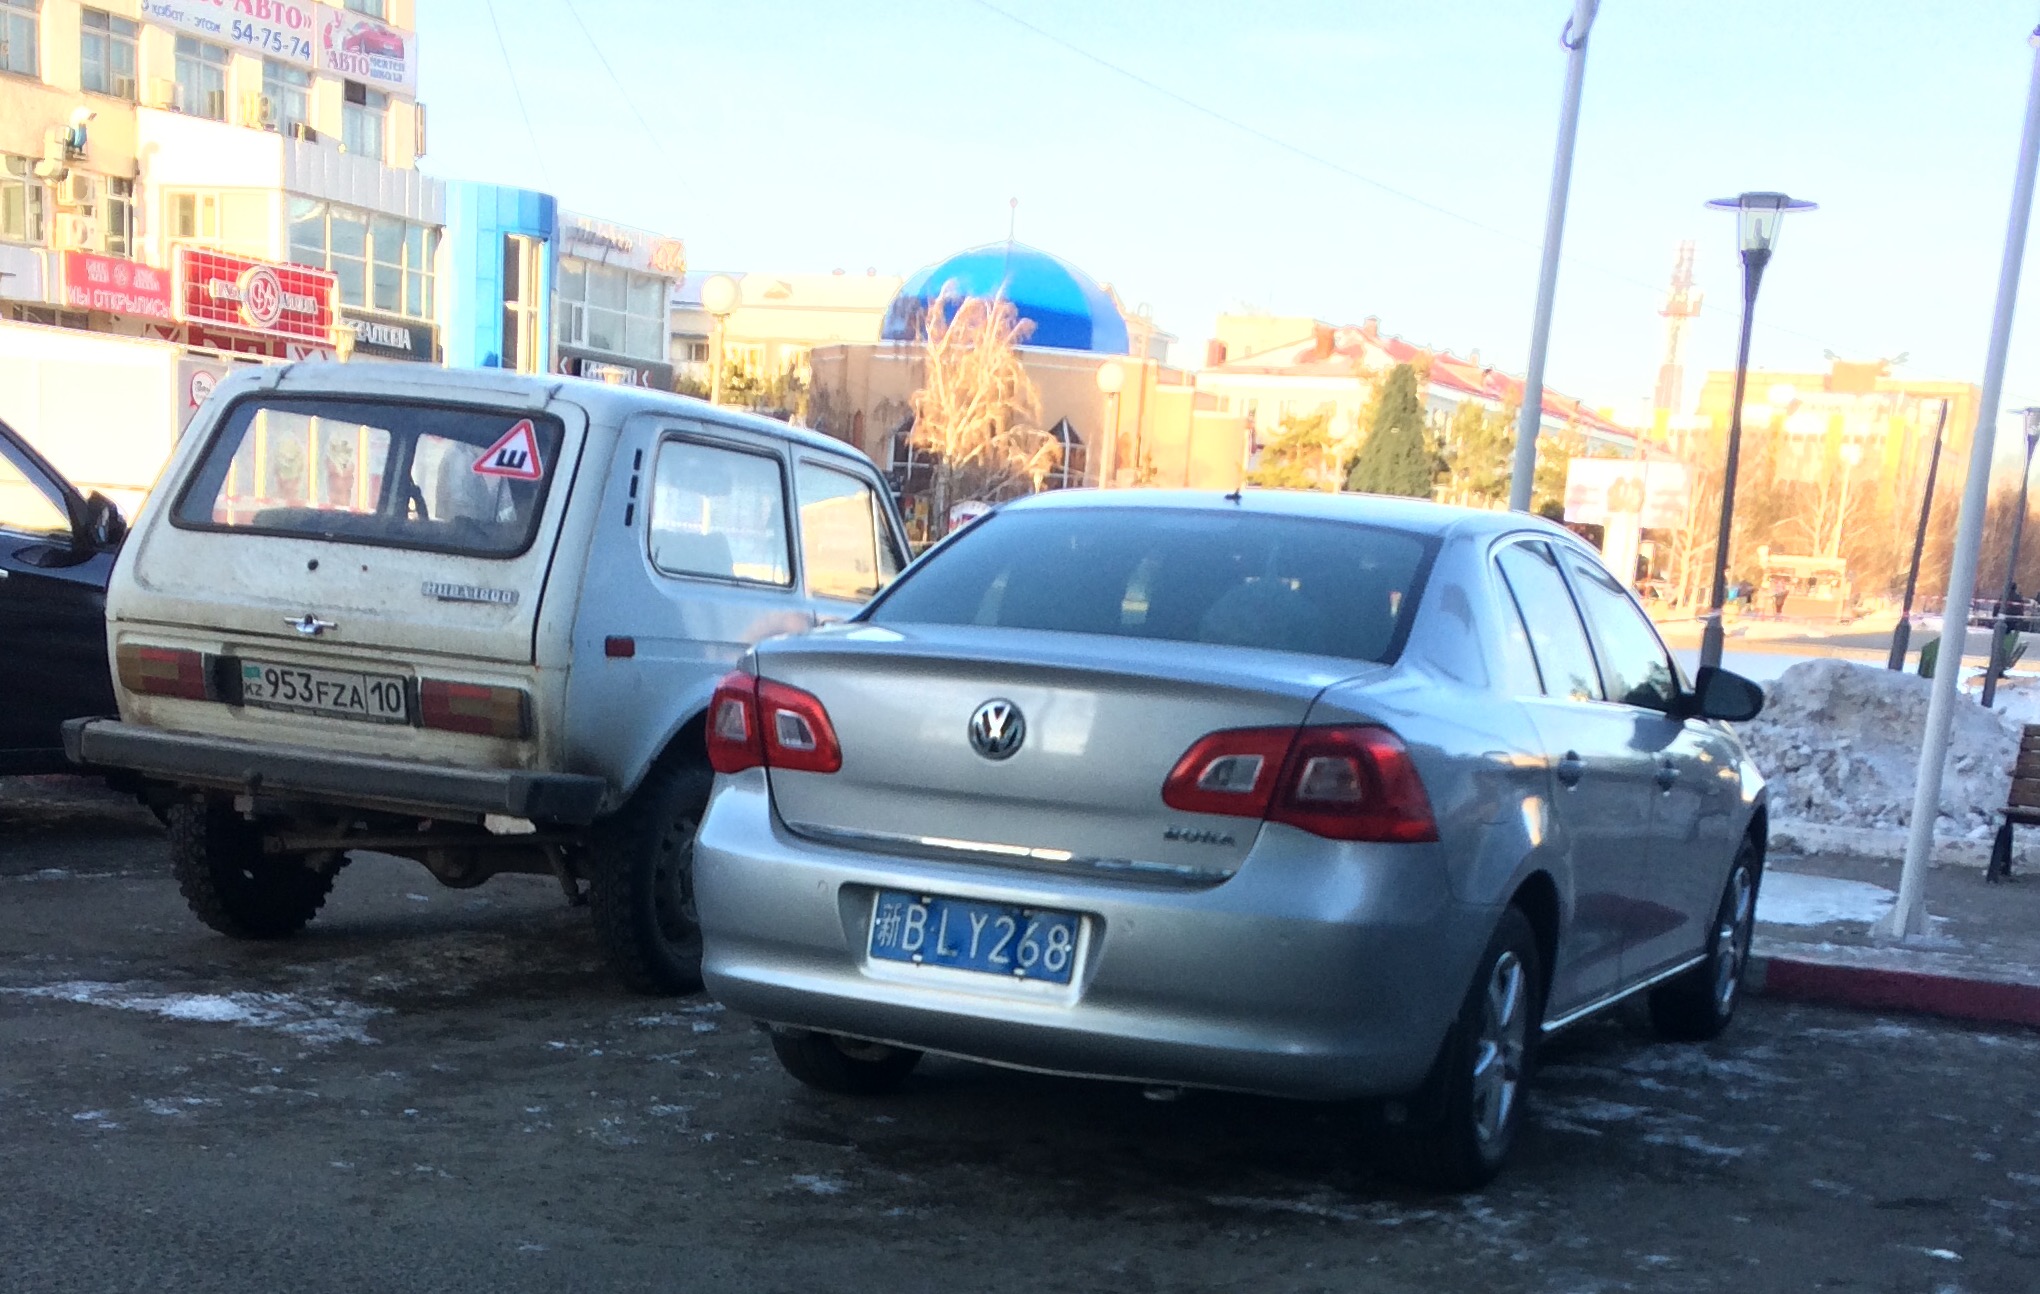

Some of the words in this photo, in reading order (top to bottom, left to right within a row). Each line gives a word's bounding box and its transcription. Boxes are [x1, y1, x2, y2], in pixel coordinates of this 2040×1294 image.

[231, 19, 311, 61] 54-75-74
[244, 682, 263, 697] KZ
[265, 668, 364, 710] 953FZA
[370, 681, 401, 713] 10
